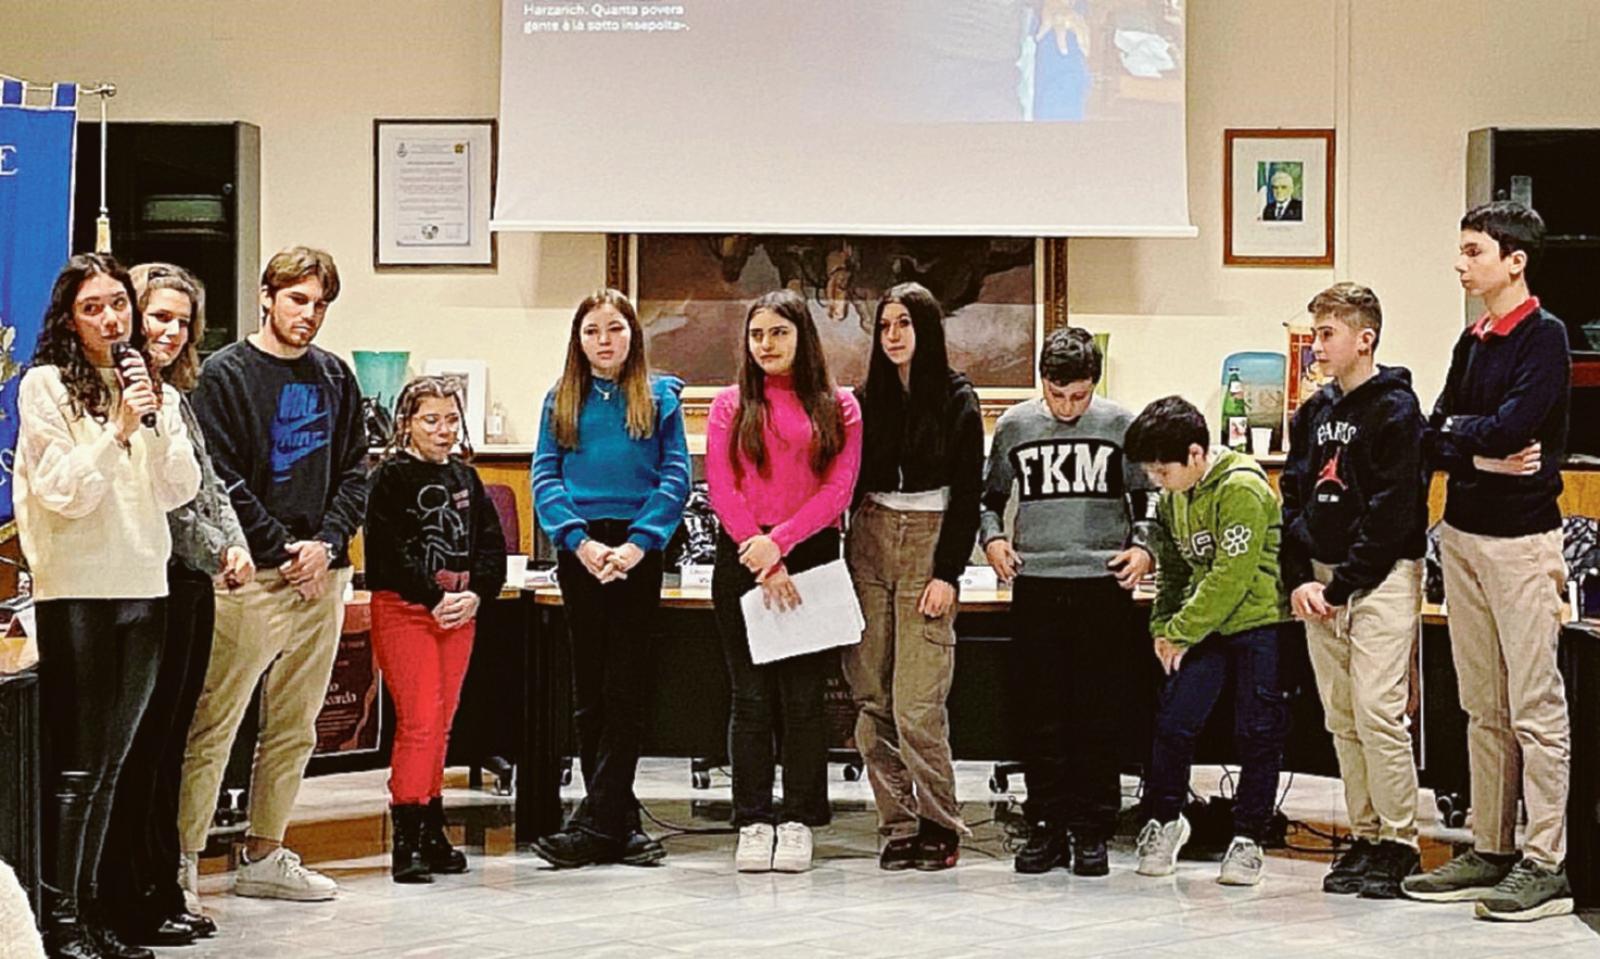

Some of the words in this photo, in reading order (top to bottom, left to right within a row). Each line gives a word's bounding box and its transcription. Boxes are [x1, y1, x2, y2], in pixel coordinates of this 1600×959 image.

[523, 3, 589, 16] Harzarich.
[591, 3, 638, 17] Quanta
[641, 5, 685, 17] povera
[523, 20, 559, 34] gente
[586, 20, 620, 32] sotto
[1016, 443, 1114, 496] FKM
